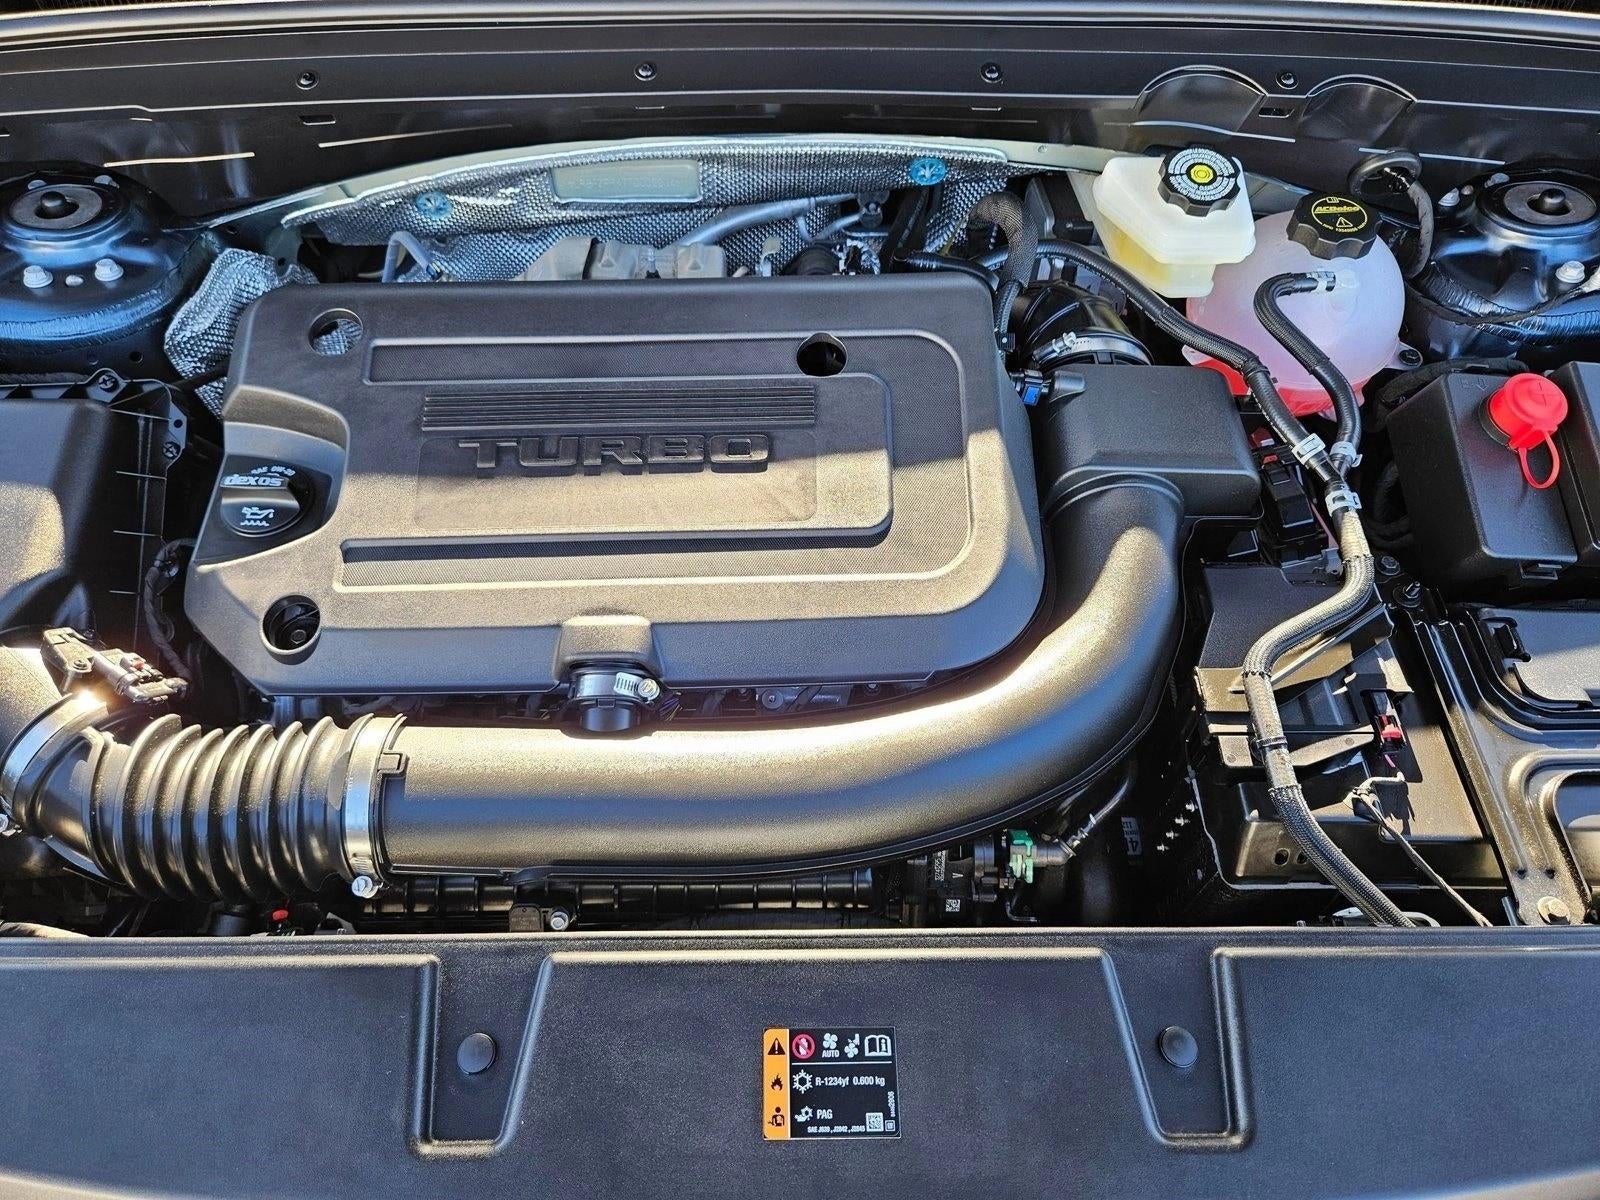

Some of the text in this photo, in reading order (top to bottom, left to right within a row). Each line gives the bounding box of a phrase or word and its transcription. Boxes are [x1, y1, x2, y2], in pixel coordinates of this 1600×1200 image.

[1315, 206, 1360, 214] ACDelco
[458, 434, 769, 471] TURBO
[224, 474, 283, 487] dexos
[822, 1050, 840, 1058] AUTO
[815, 1076, 885, 1087] R-1234yf 0.600 kg
[816, 1109, 833, 1119] PAG
